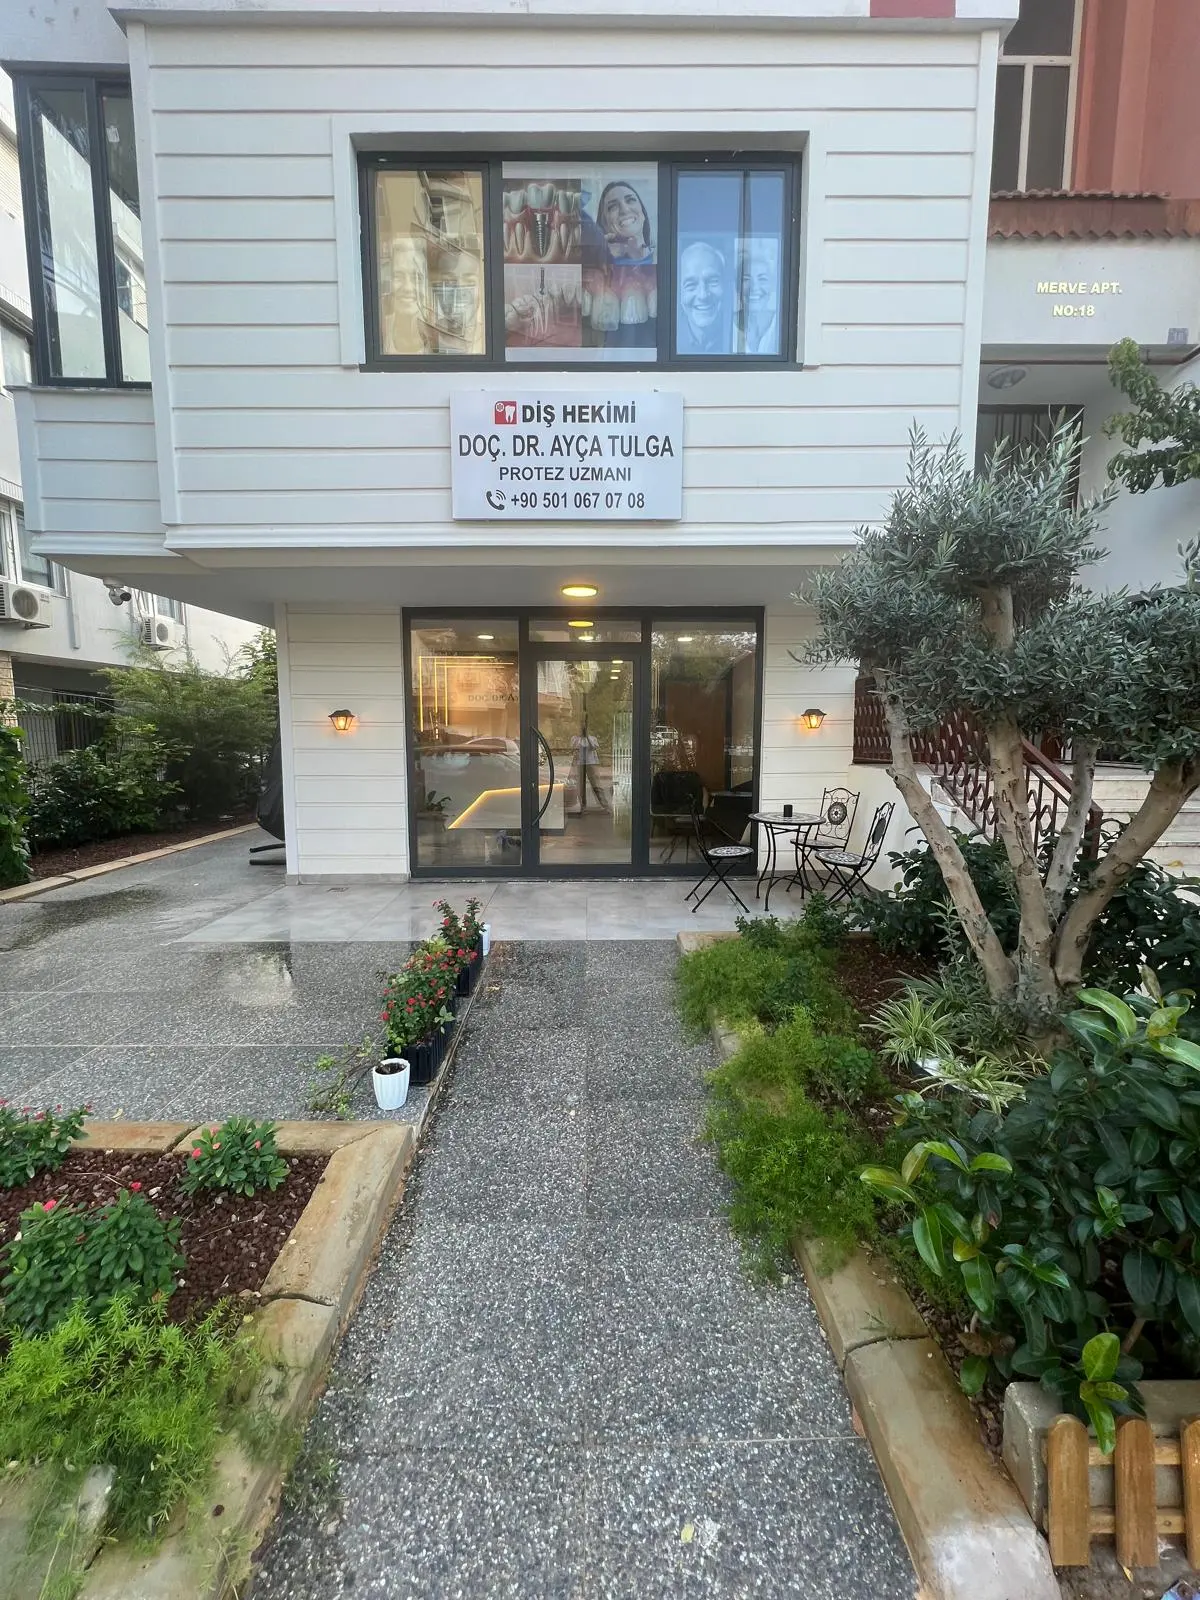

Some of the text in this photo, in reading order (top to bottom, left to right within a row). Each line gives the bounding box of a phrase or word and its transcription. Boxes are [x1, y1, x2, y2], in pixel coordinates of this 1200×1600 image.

[1037, 281, 1123, 294] MERVE APT.
[1053, 304, 1096, 317] NO:18
[522, 400, 637, 428] DİŞ HEKİMİ
[458, 434, 674, 462] DOÇ. DR. AYÇA TULGA
[499, 466, 631, 481] PROTEZ UZMANI
[511, 493, 645, 508] +90 501 067 07 08
